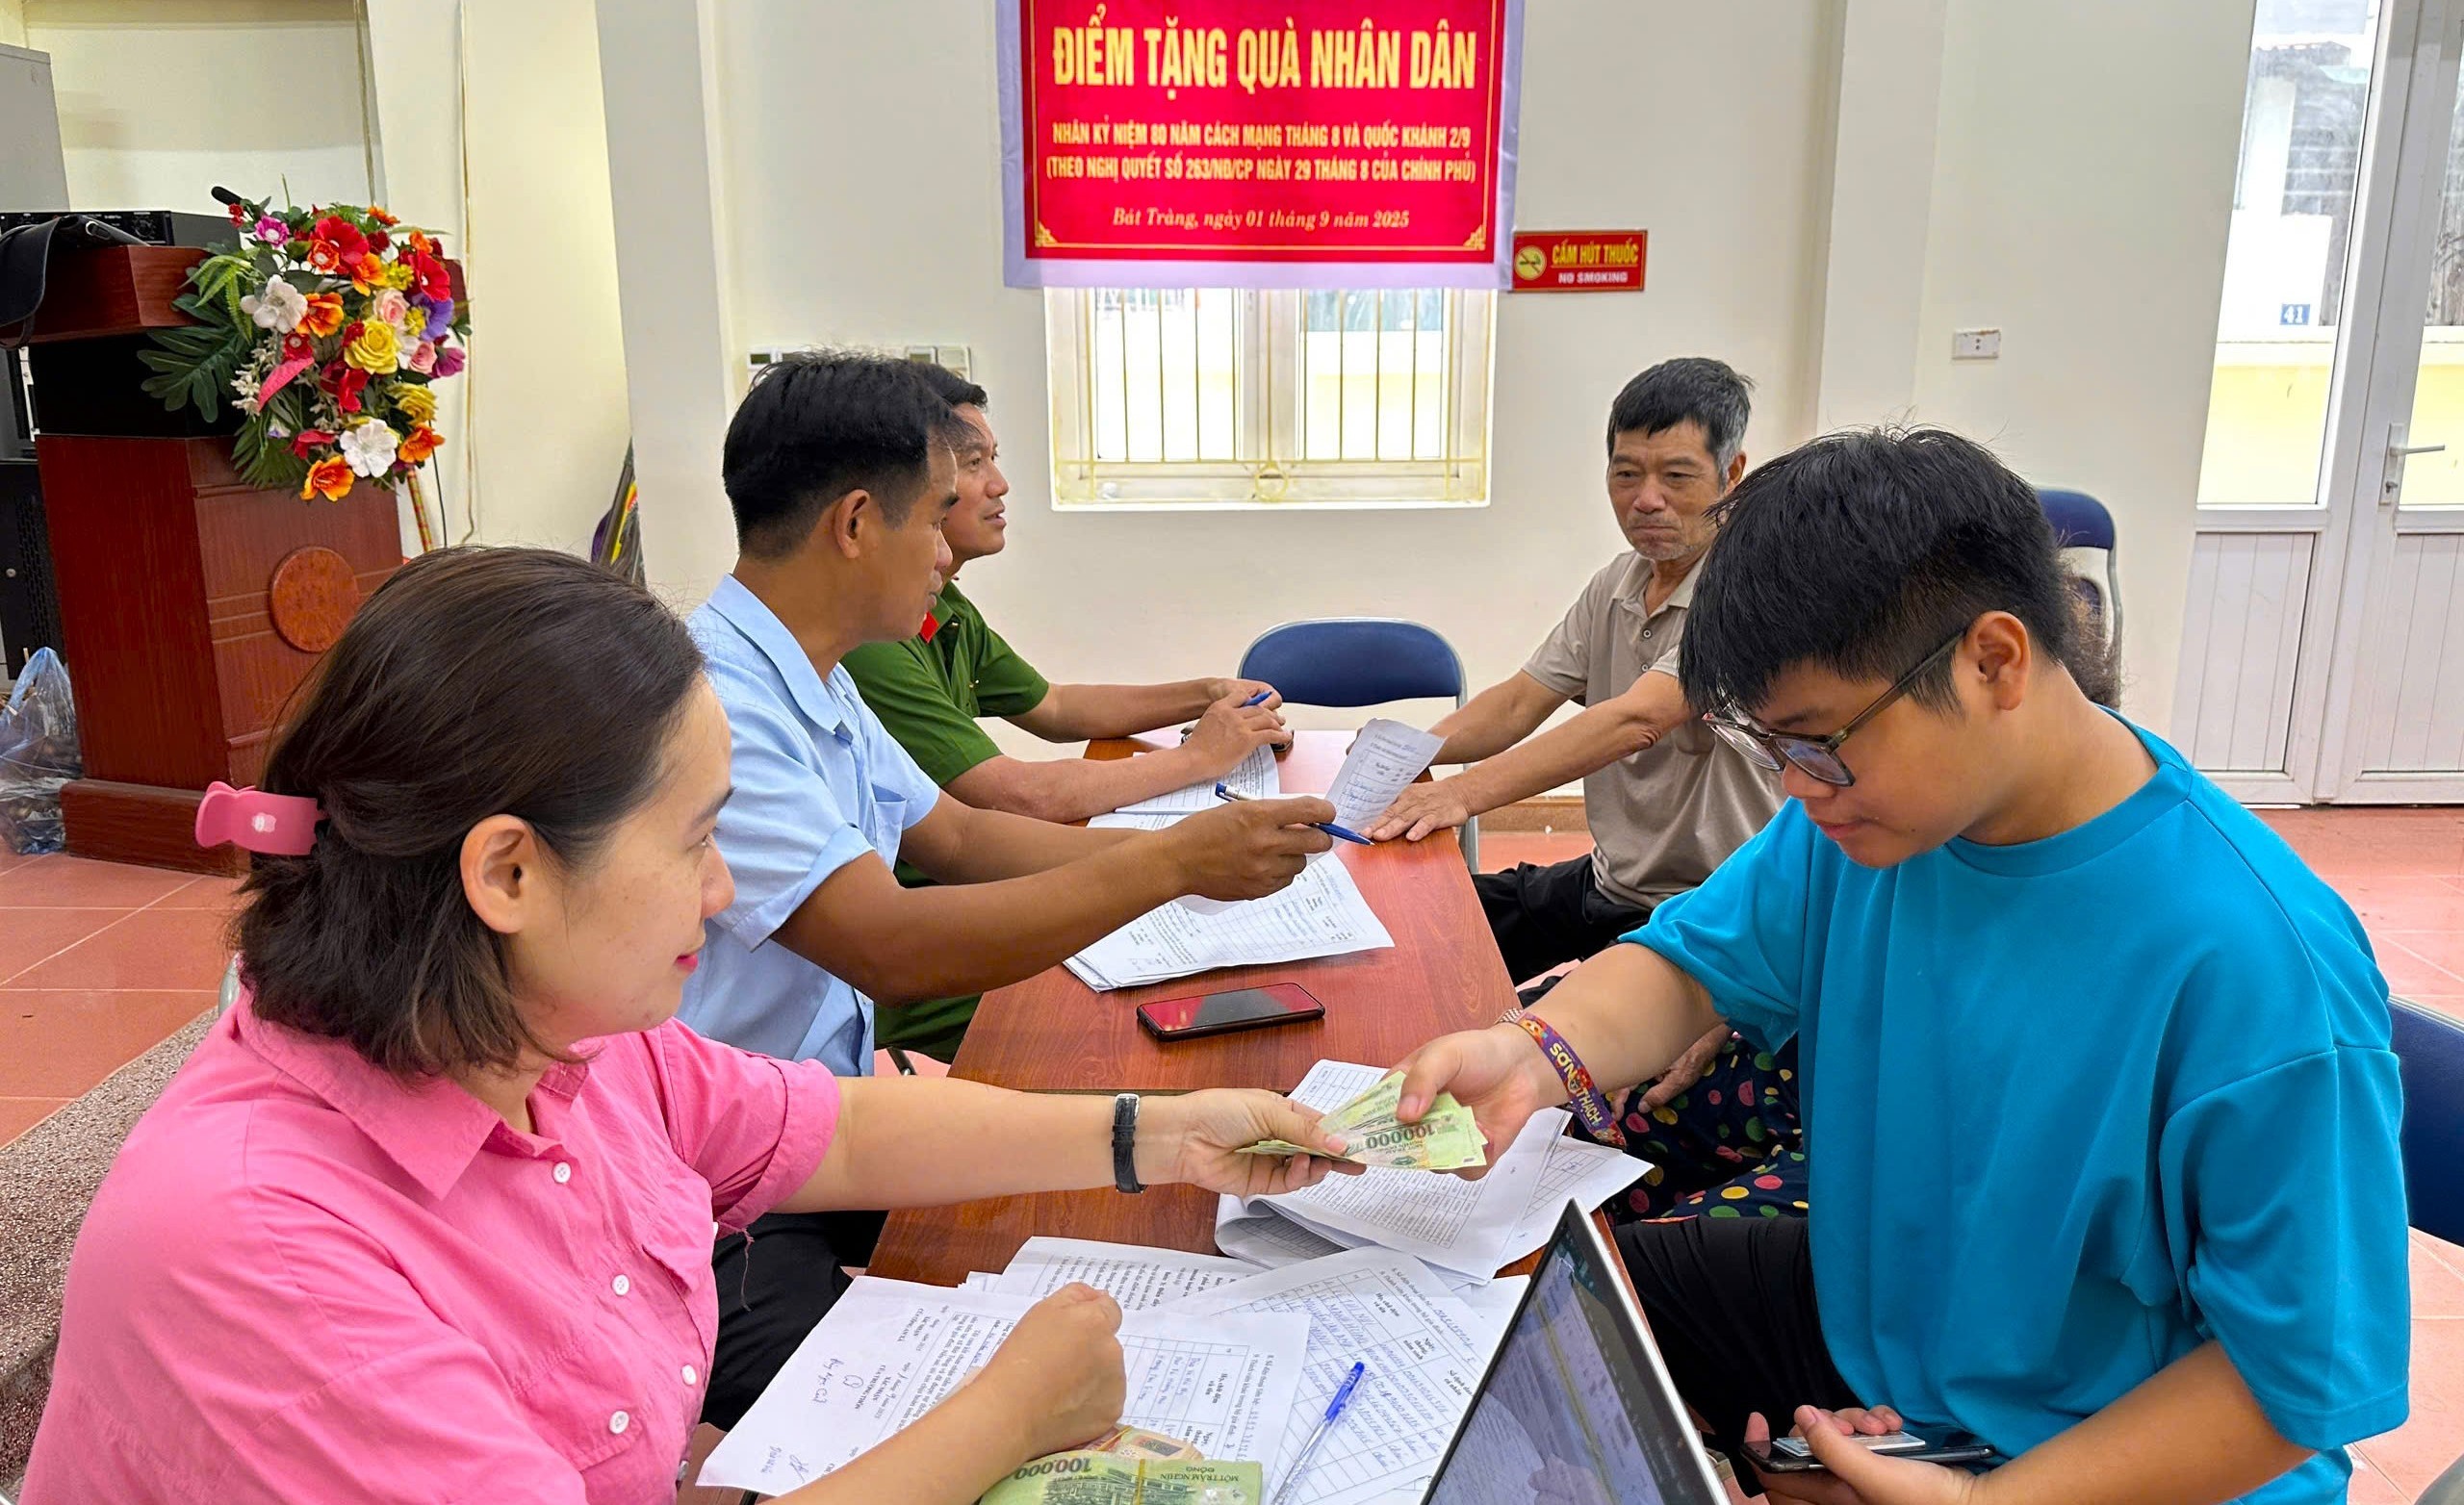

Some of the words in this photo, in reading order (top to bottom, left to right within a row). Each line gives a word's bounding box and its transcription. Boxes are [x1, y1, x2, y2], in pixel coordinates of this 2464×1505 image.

[1053, 3, 1134, 86] ĐIỂM
[1143, 15, 1227, 101] TẶNG
[1237, 16, 1301, 94] QUÀ
[1310, 17, 1401, 89] NHÂN
[1409, 18, 1476, 89] DÂN
[1052, 118, 1090, 144] NHÂN
[1092, 114, 1110, 144] KỶ
[1113, 119, 1147, 150] NIỆM
[1150, 123, 1168, 146] 80
[1169, 119, 1201, 146] NĂM
[1203, 119, 1240, 146] CÁCH
[1242, 124, 1282, 151] MẠNG
[1285, 120, 1328, 147] THÁNG
[1330, 125, 1341, 147] 8
[1343, 121, 1360, 147] VÀ
[1363, 118, 1399, 150] QUỐC
[1401, 121, 1447, 148] KHÁNH
[1449, 126, 1471, 148] 2/9
[1046, 155, 1084, 180] (THEO
[1086, 155, 1119, 184] NGHỊ
[1121, 150, 1162, 181] QUYẾT
[1164, 150, 1183, 179] SỐ
[1256, 154, 1292, 181] NGÀY
[1294, 159, 1311, 181] 29
[1314, 154, 1357, 181] THÁNG
[1360, 158, 1370, 181] 8
[1371, 150, 1399, 181] CỦA
[1401, 154, 1443, 181] CHÍNH
[1445, 150, 1476, 184] PHỦ)
[1113, 207, 1142, 226] Bát
[1146, 207, 1198, 230] Tràng,
[1203, 209, 1243, 231] ngày
[1245, 210, 1264, 228] 01
[1269, 209, 1316, 232] tháng
[1320, 210, 1330, 228] 9
[1334, 211, 1370, 227] năm
[1373, 209, 1410, 228] 2025
[1552, 239, 1578, 265] CẤM
[1579, 242, 1602, 265] HÚT
[1604, 238, 1639, 265] THUỐC
[1558, 272, 1575, 284] NO
[1577, 271, 1629, 284] SMOKING
[2283, 305, 2304, 323] 41
[1550, 1042, 1580, 1085] SƠN
[1576, 1087, 1603, 1124] THẠCH
